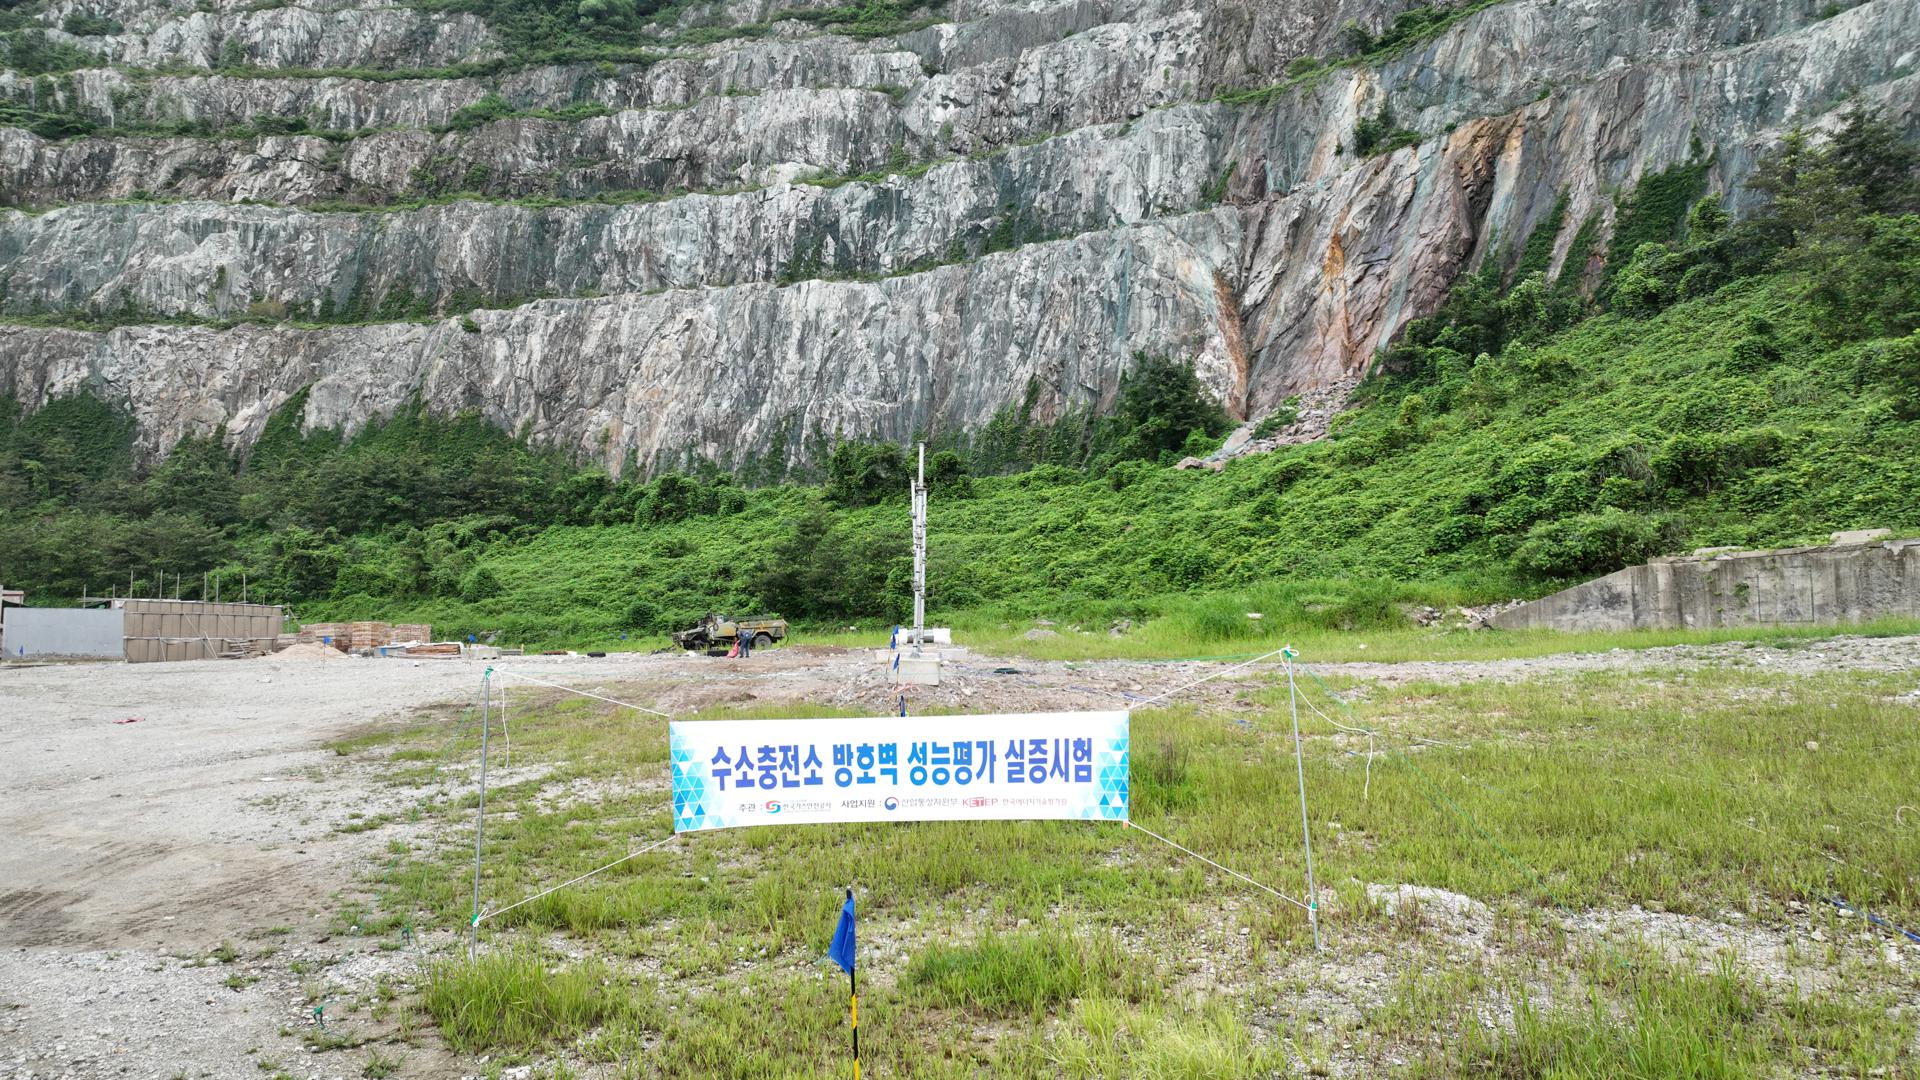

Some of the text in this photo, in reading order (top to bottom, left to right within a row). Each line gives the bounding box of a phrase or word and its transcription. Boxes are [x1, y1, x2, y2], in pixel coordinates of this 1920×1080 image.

[711, 737, 1092, 791] 수소충전소 방호벽 성능평가 실증시험
[841, 799, 876, 808] 사업지원
[901, 798, 958, 808] 산업통상자원부
[962, 797, 998, 807] KETEP
[738, 803, 756, 812] 주관
